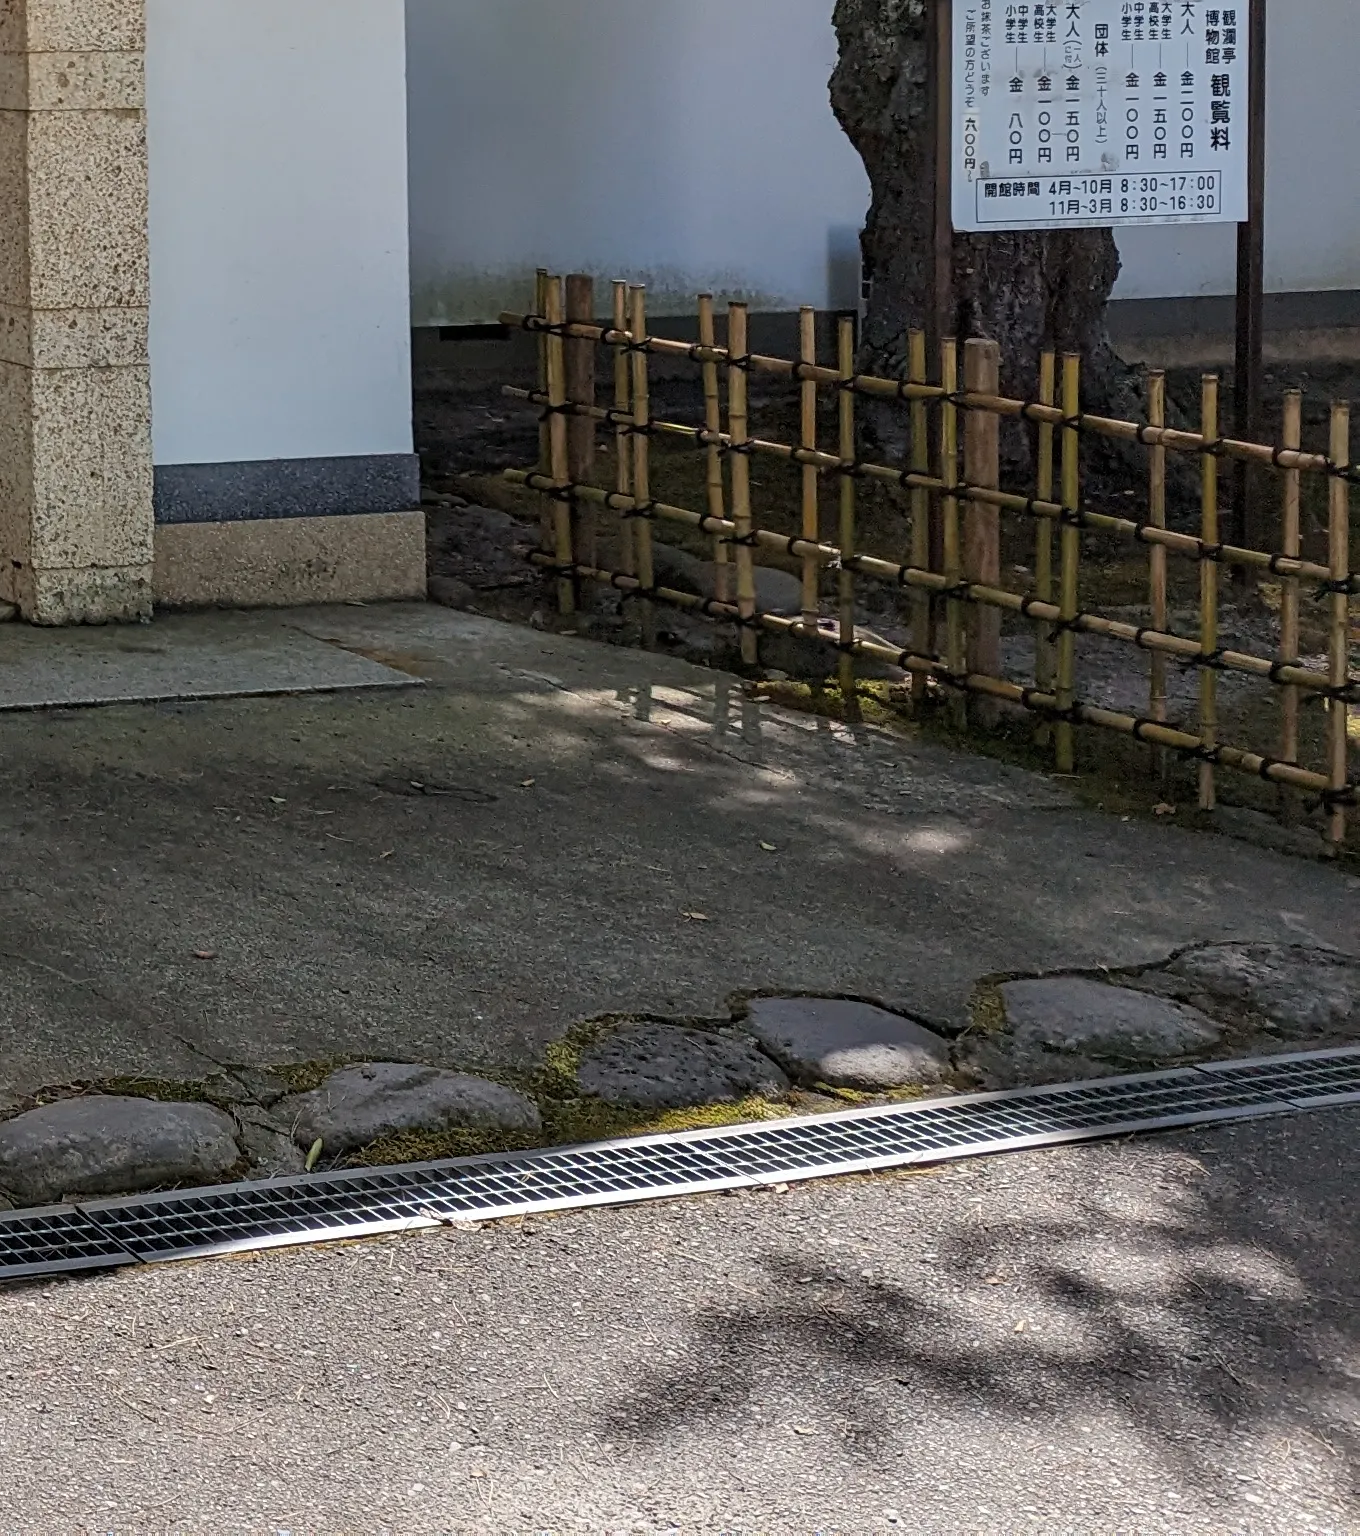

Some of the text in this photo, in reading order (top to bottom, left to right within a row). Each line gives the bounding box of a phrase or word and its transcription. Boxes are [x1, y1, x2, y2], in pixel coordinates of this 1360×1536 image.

[1005, 5, 1017, 44] 小学生
[1018, 5, 1029, 44] 中学生
[1034, 4, 1044, 43] 高校生
[1046, 4, 1057, 43] 大学生
[1066, 4, 1080, 37] 大人
[1121, 2, 1132, 41] 小学生
[1134, 2, 1144, 41] 中学生
[1148, 2, 1159, 40] 高校生
[1161, 2, 1172, 40] 大学生
[1180, 2, 1194, 35] 大人
[1205, 10, 1220, 64] 博物館
[1095, 24, 1109, 57] 団体
[1211, 74, 1231, 151] 観覧料
[984, 182, 1040, 198] 開館時間
